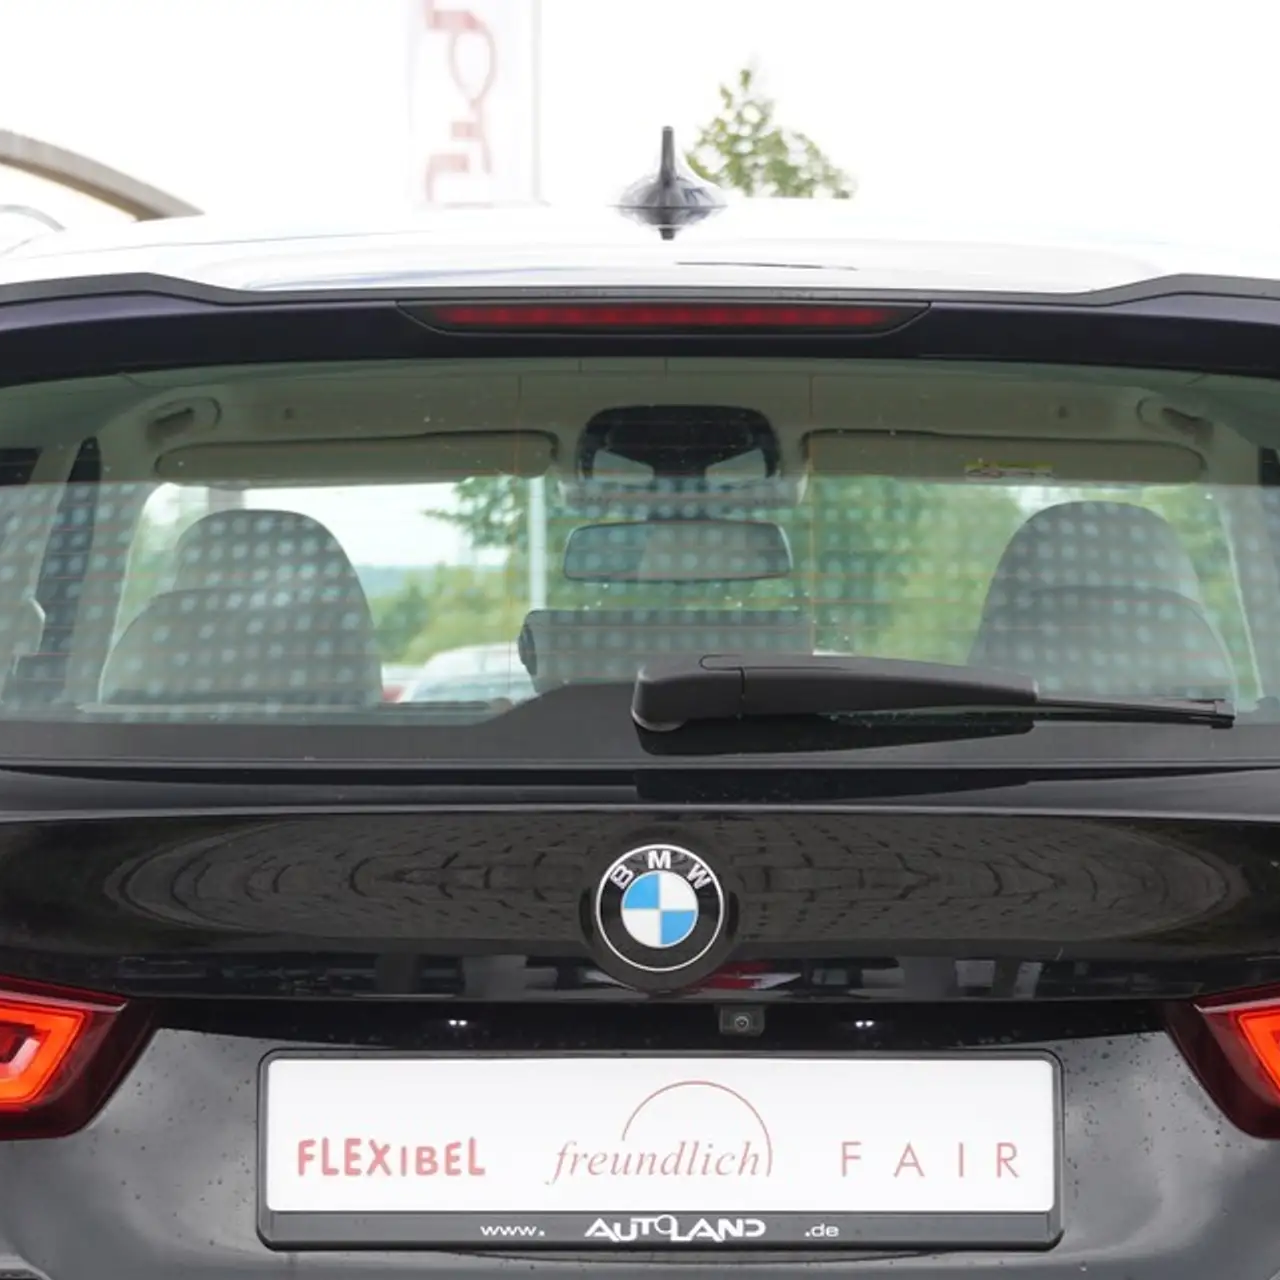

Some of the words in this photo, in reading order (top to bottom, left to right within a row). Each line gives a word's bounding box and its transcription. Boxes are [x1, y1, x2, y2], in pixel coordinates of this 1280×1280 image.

[610, 850, 712, 889] BMW
[298, 1137, 486, 1177] FLEXIBEL
[544, 1140, 761, 1186] freundlich
[841, 1142, 1019, 1178] FAIR
[480, 1225, 546, 1237] www.
[584, 1214, 767, 1243] AUTOLAND
